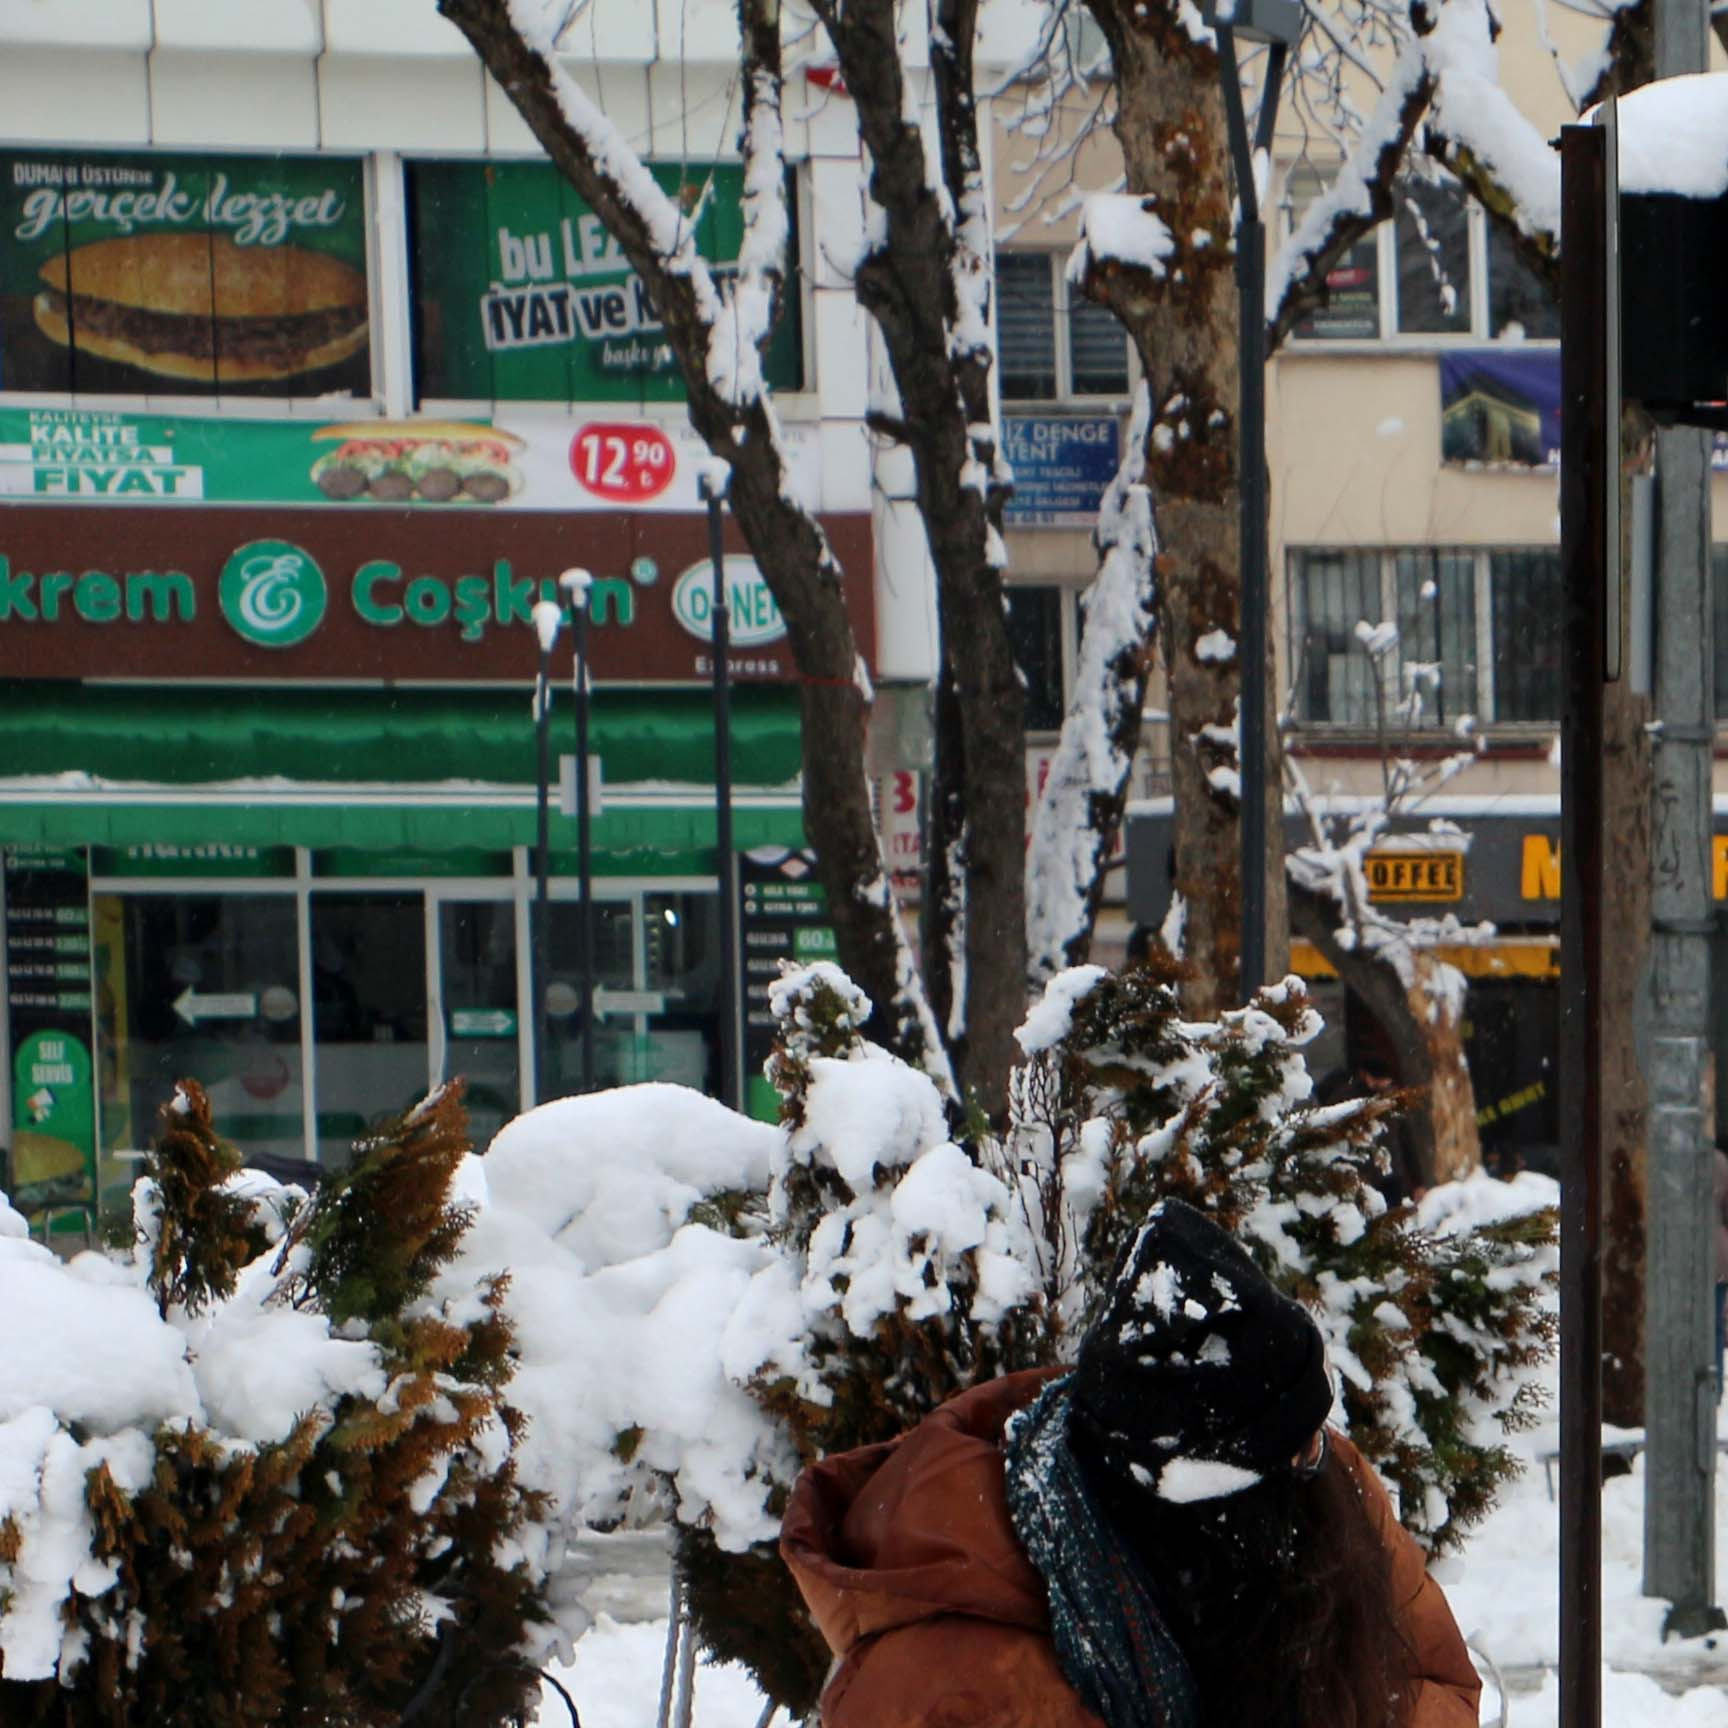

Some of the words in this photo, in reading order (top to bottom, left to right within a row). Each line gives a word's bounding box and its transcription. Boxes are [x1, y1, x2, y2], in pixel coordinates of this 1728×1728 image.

[15, 173, 200, 240] gerçek
[202, 172, 346, 246] lezzet
[499, 227, 553, 281] bu
[578, 289, 625, 331] ve
[34, 466, 186, 494] FİYAT
[695, 655, 780, 675] Eress
[1371, 860, 1457, 886] OFFEE
[38, 1040, 65, 1061] SELF
